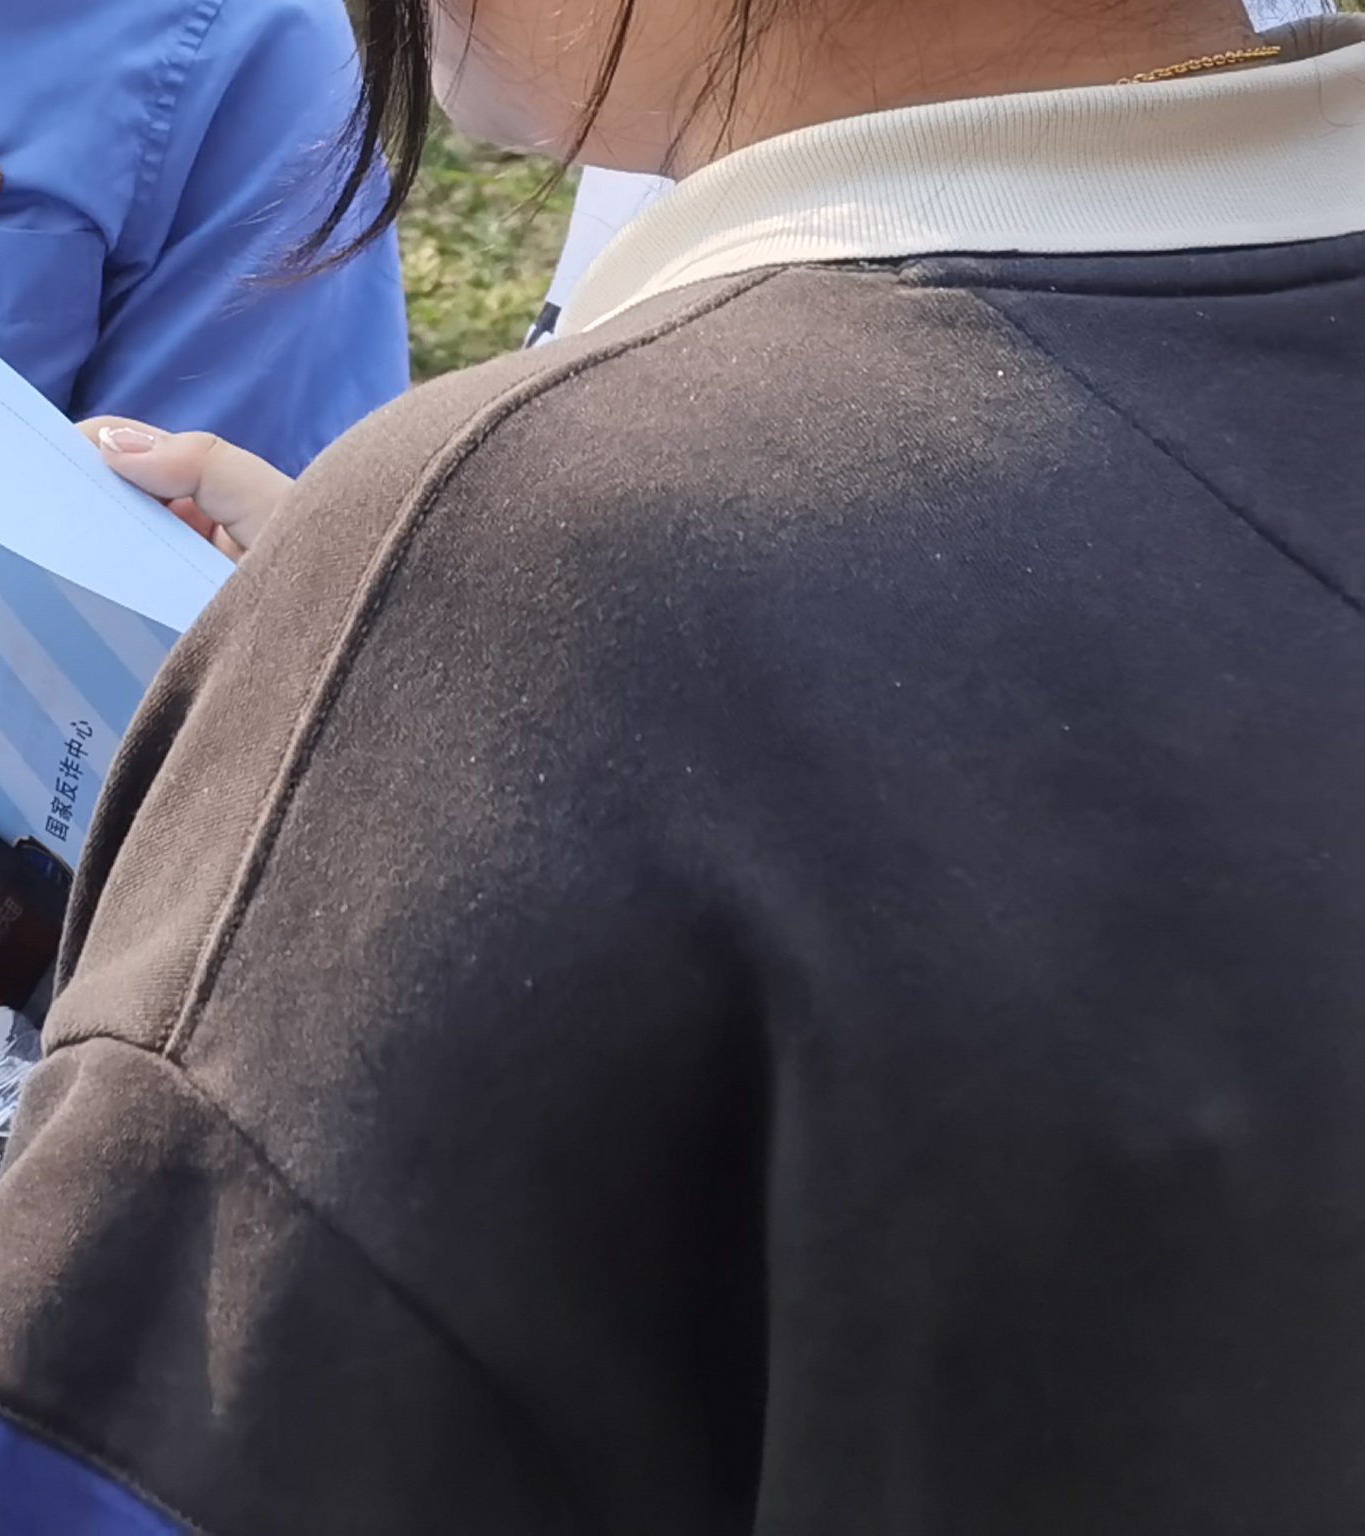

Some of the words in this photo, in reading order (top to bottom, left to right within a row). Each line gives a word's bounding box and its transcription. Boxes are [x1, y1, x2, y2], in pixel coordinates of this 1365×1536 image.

[45, 719, 93, 842] 国家反诈中心
